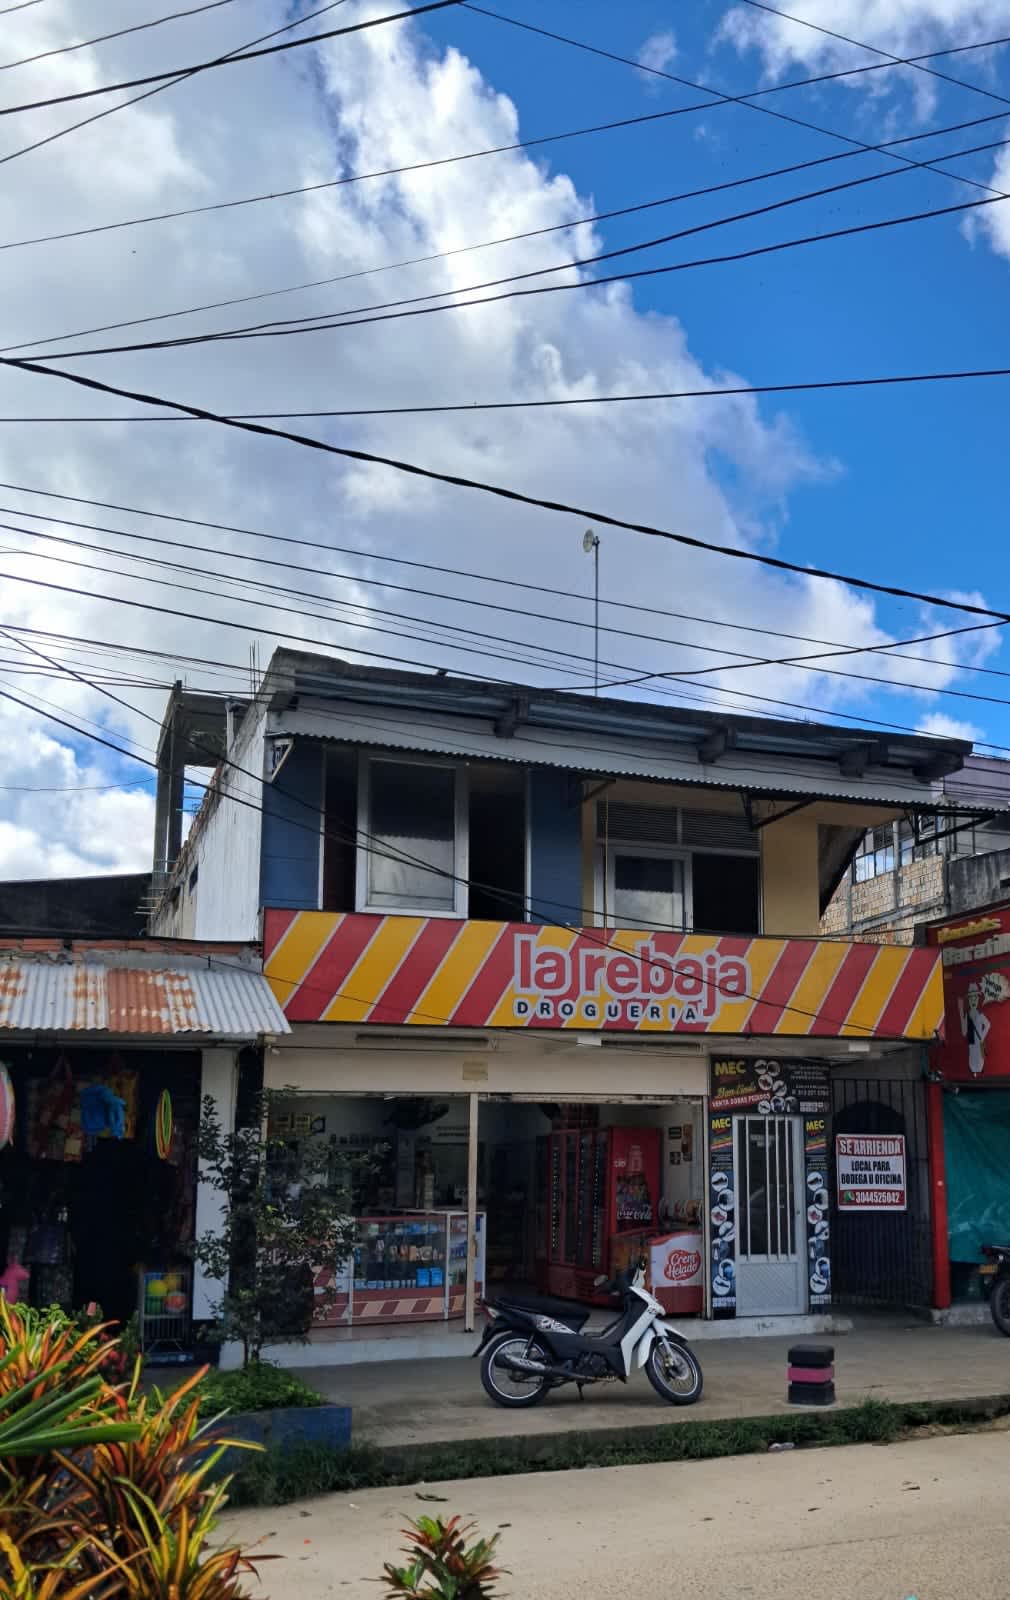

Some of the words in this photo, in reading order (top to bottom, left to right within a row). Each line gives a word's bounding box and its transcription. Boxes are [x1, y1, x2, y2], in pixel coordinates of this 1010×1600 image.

[518, 939, 567, 990] la
[584, 945, 748, 1017] rebaja
[516, 1001, 697, 1020] DROGUERIA
[714, 1061, 746, 1077] MEC
[711, 1118, 731, 1129] MEC
[806, 1119, 825, 1131] MEC
[840, 1139, 852, 1154] SE
[854, 1140, 902, 1155] ARRIENDA
[851, 1160, 872, 1171] LOCAL
[873, 1160, 891, 1171] PARA
[841, 1173, 868, 1185] BODEGA
[868, 1173, 874, 1185] U
[875, 1173, 902, 1185] OFICINA
[670, 1253, 697, 1267] Crem
[667, 1260, 698, 1278] Helado
